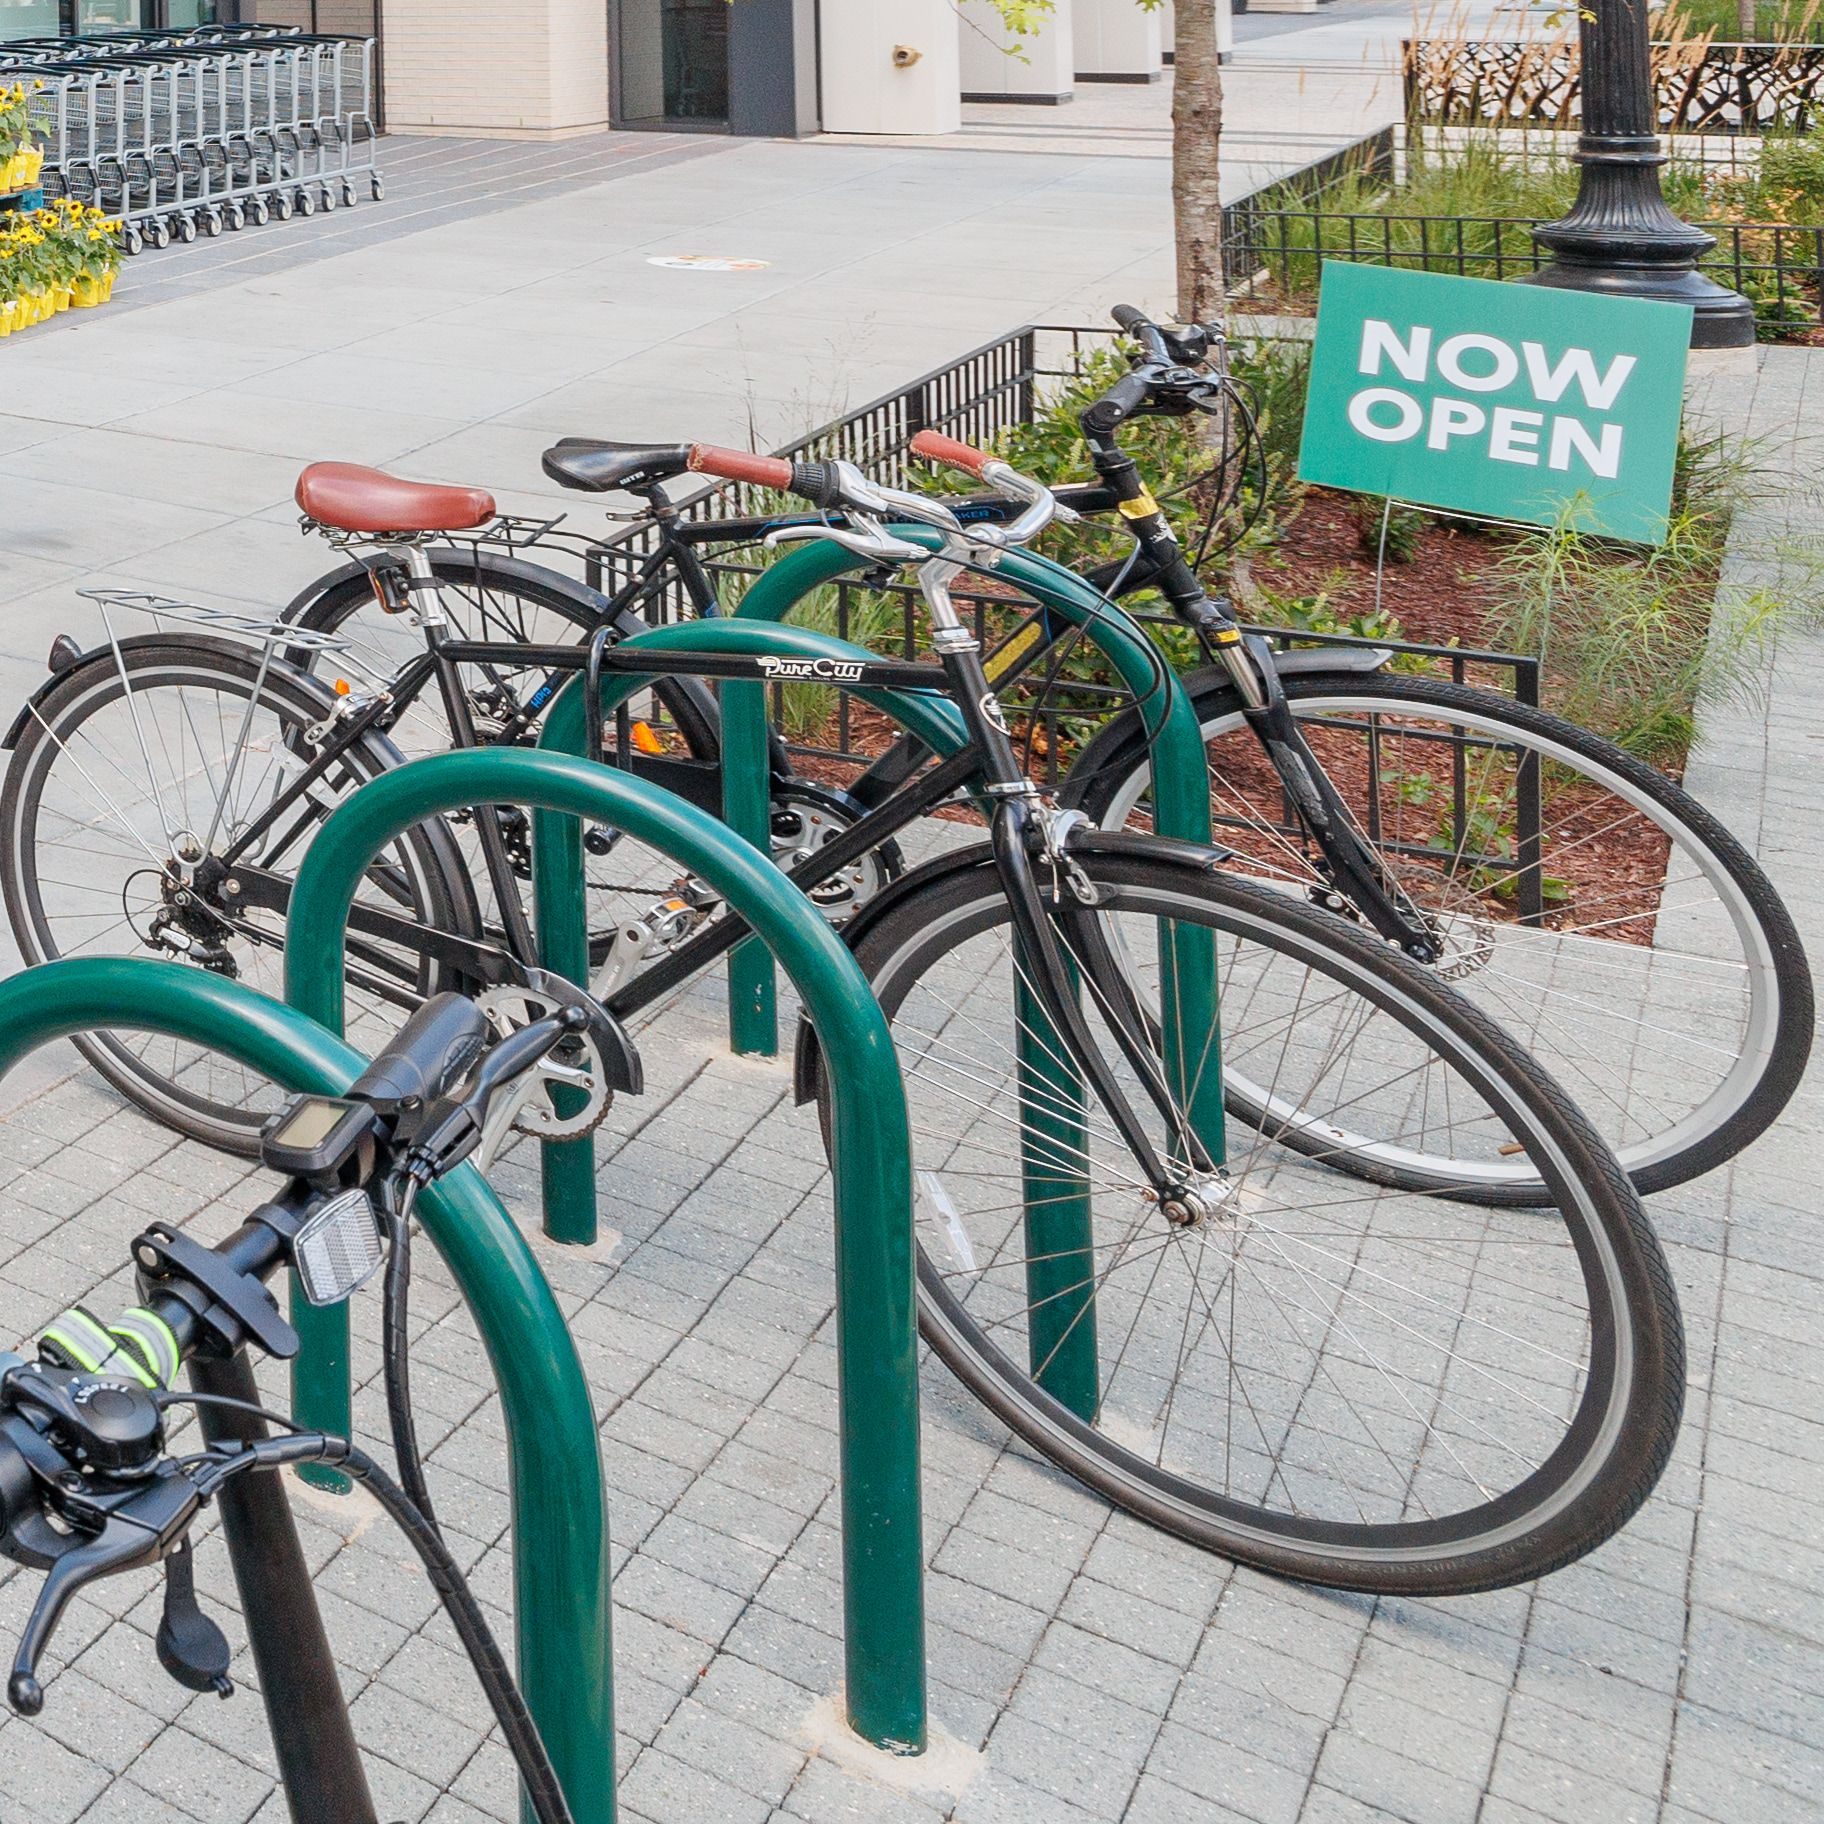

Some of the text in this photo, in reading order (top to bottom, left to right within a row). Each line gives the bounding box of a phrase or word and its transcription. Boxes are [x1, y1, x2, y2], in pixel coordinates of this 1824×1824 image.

[1358, 319, 1638, 410] NOW
[1347, 387, 1624, 480] OPEN
[755, 655, 866, 682] Pure City
